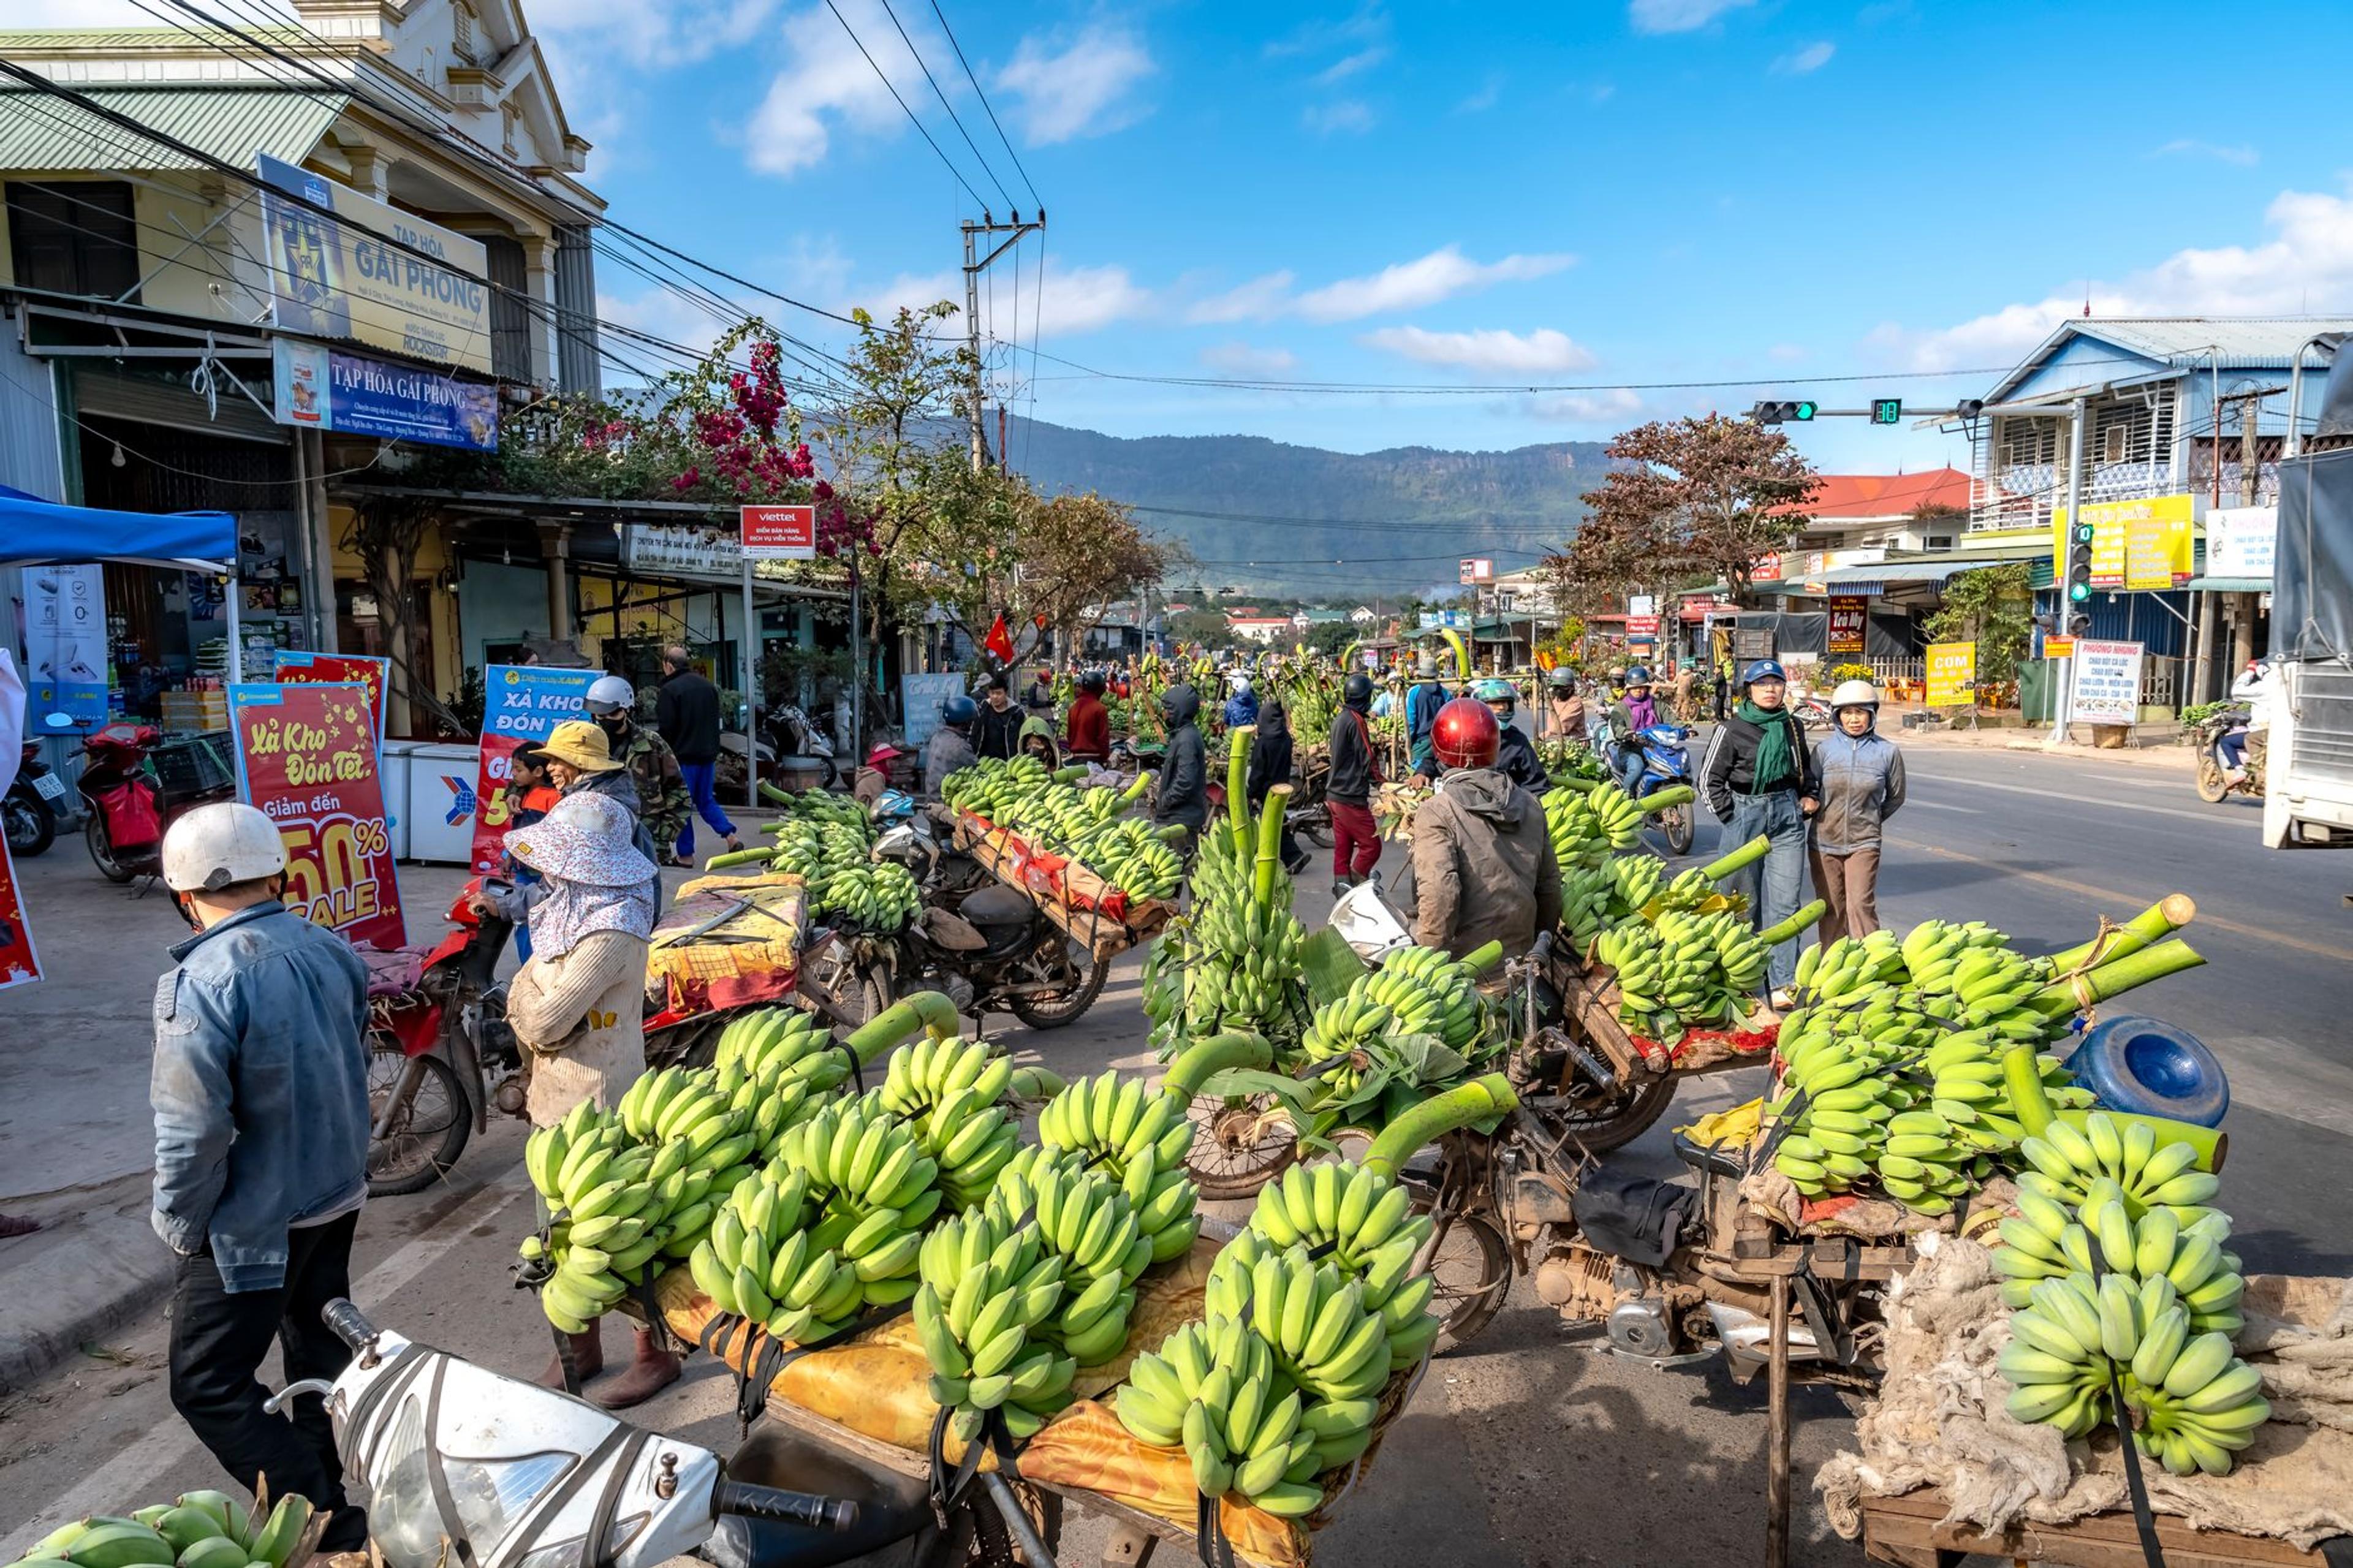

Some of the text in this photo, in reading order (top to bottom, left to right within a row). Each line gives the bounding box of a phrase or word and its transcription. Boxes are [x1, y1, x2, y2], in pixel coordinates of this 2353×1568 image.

[406, 259, 482, 314] PHONG
[332, 364, 362, 393] TẠP
[365, 368, 395, 395] HÓA
[397, 374, 420, 401] GÁI
[423, 382, 466, 409] PHONG
[759, 512, 797, 521] viettel
[1849, 612, 1864, 631] My
[502, 687, 585, 711] XẢ KHO
[496, 711, 546, 732] ĐÓN
[250, 718, 327, 755] Xả Kho
[284, 752, 333, 786] Đón
[263, 792, 341, 817] Giảm đến
[280, 819, 387, 907] 50%
